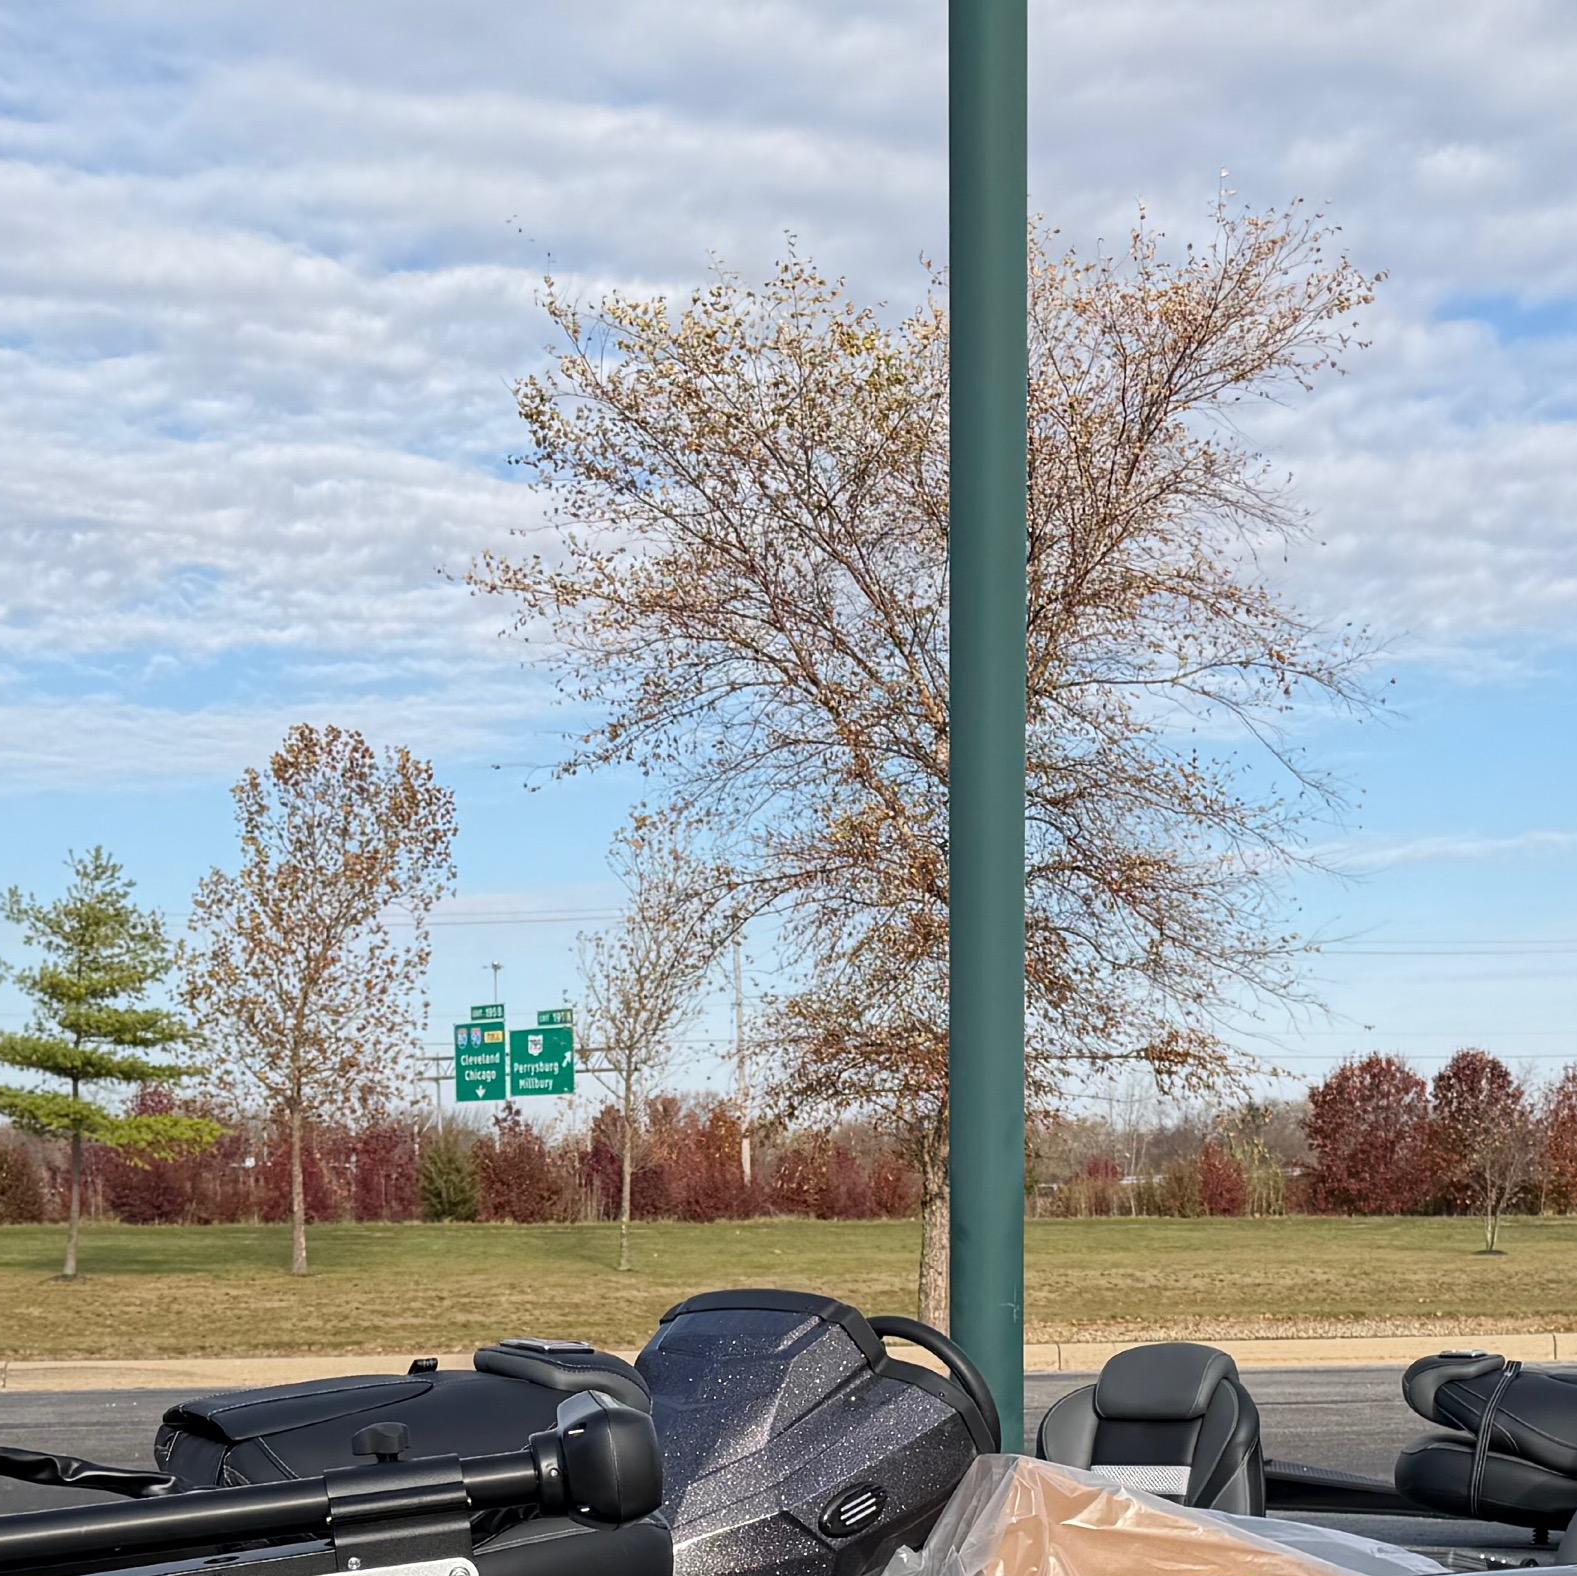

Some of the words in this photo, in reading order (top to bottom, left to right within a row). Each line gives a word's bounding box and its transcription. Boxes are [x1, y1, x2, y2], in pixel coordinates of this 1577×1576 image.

[461, 1052, 500, 1065] Cleveland
[513, 1061, 559, 1076] Perrysburg
[465, 1069, 496, 1082] Chicago
[519, 1077, 553, 1090] Millbury
